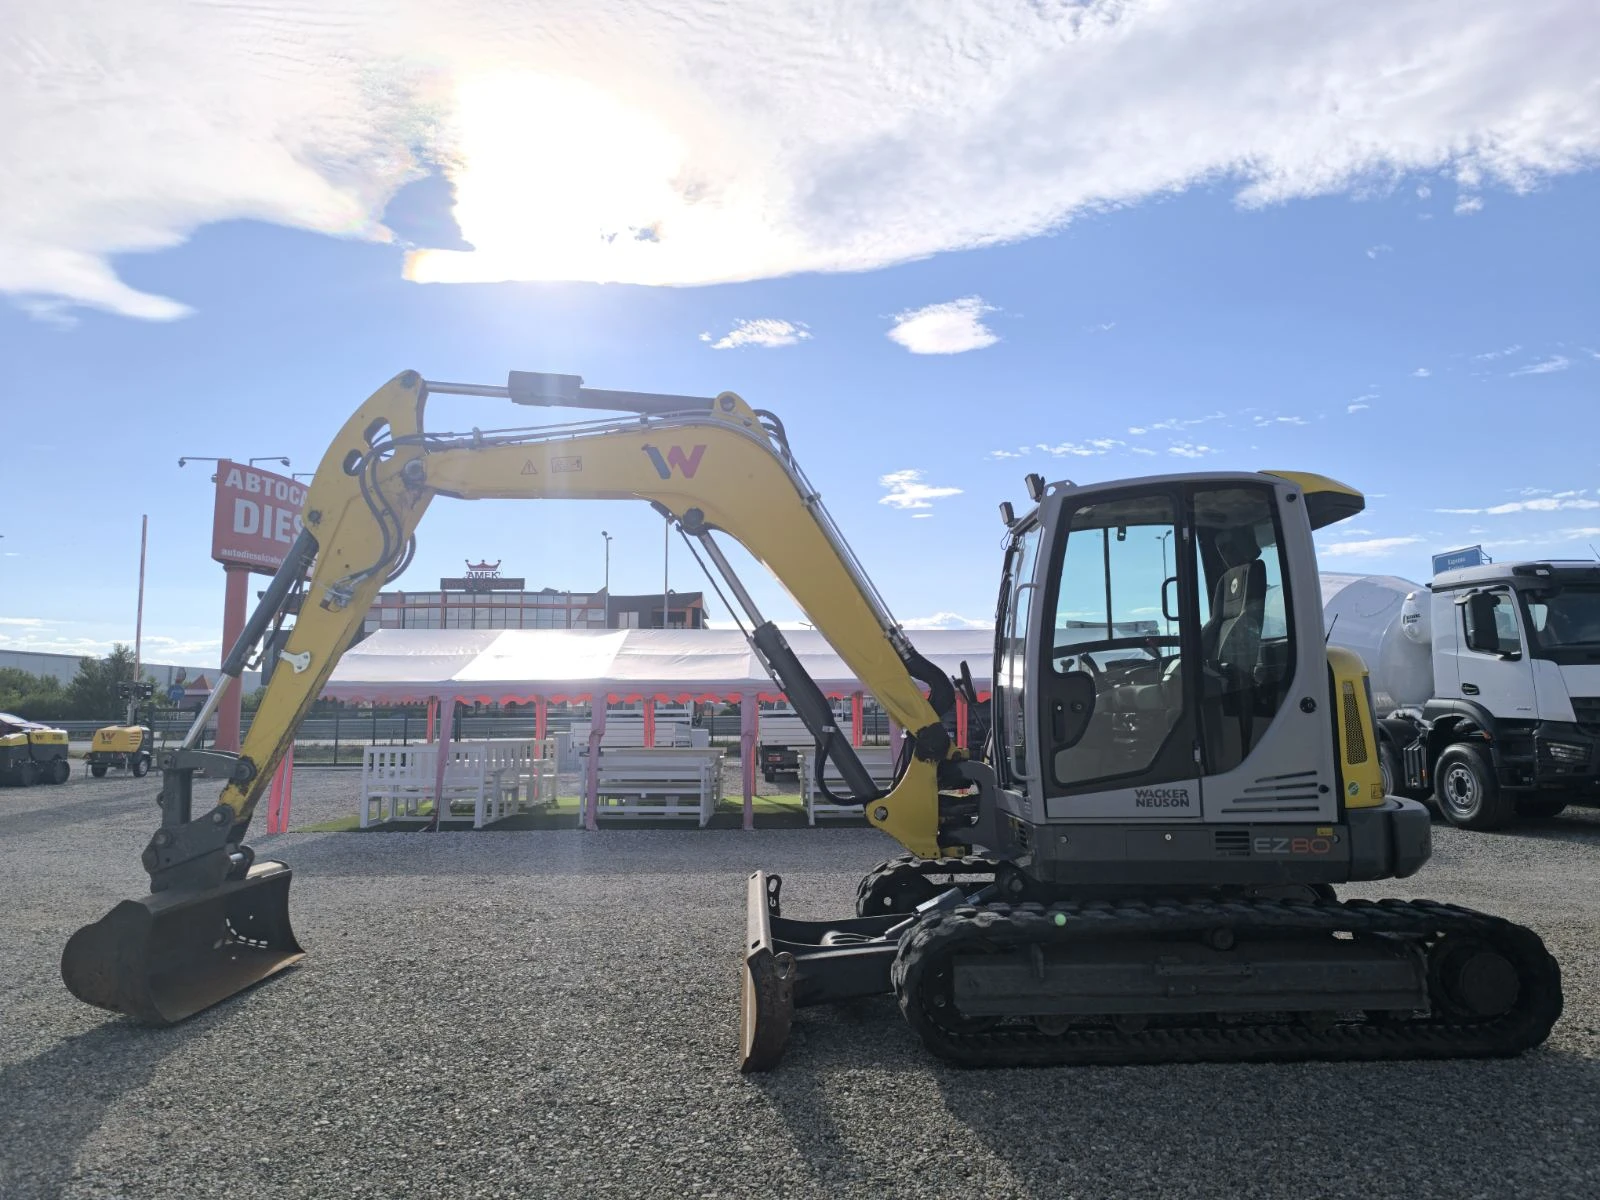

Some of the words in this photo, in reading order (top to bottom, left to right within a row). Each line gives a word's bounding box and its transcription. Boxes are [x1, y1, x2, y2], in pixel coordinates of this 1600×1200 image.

[1135, 789, 1188, 798] WACKER
[1135, 798, 1190, 807] NEUSON
[1254, 838, 1330, 853] EZ80
